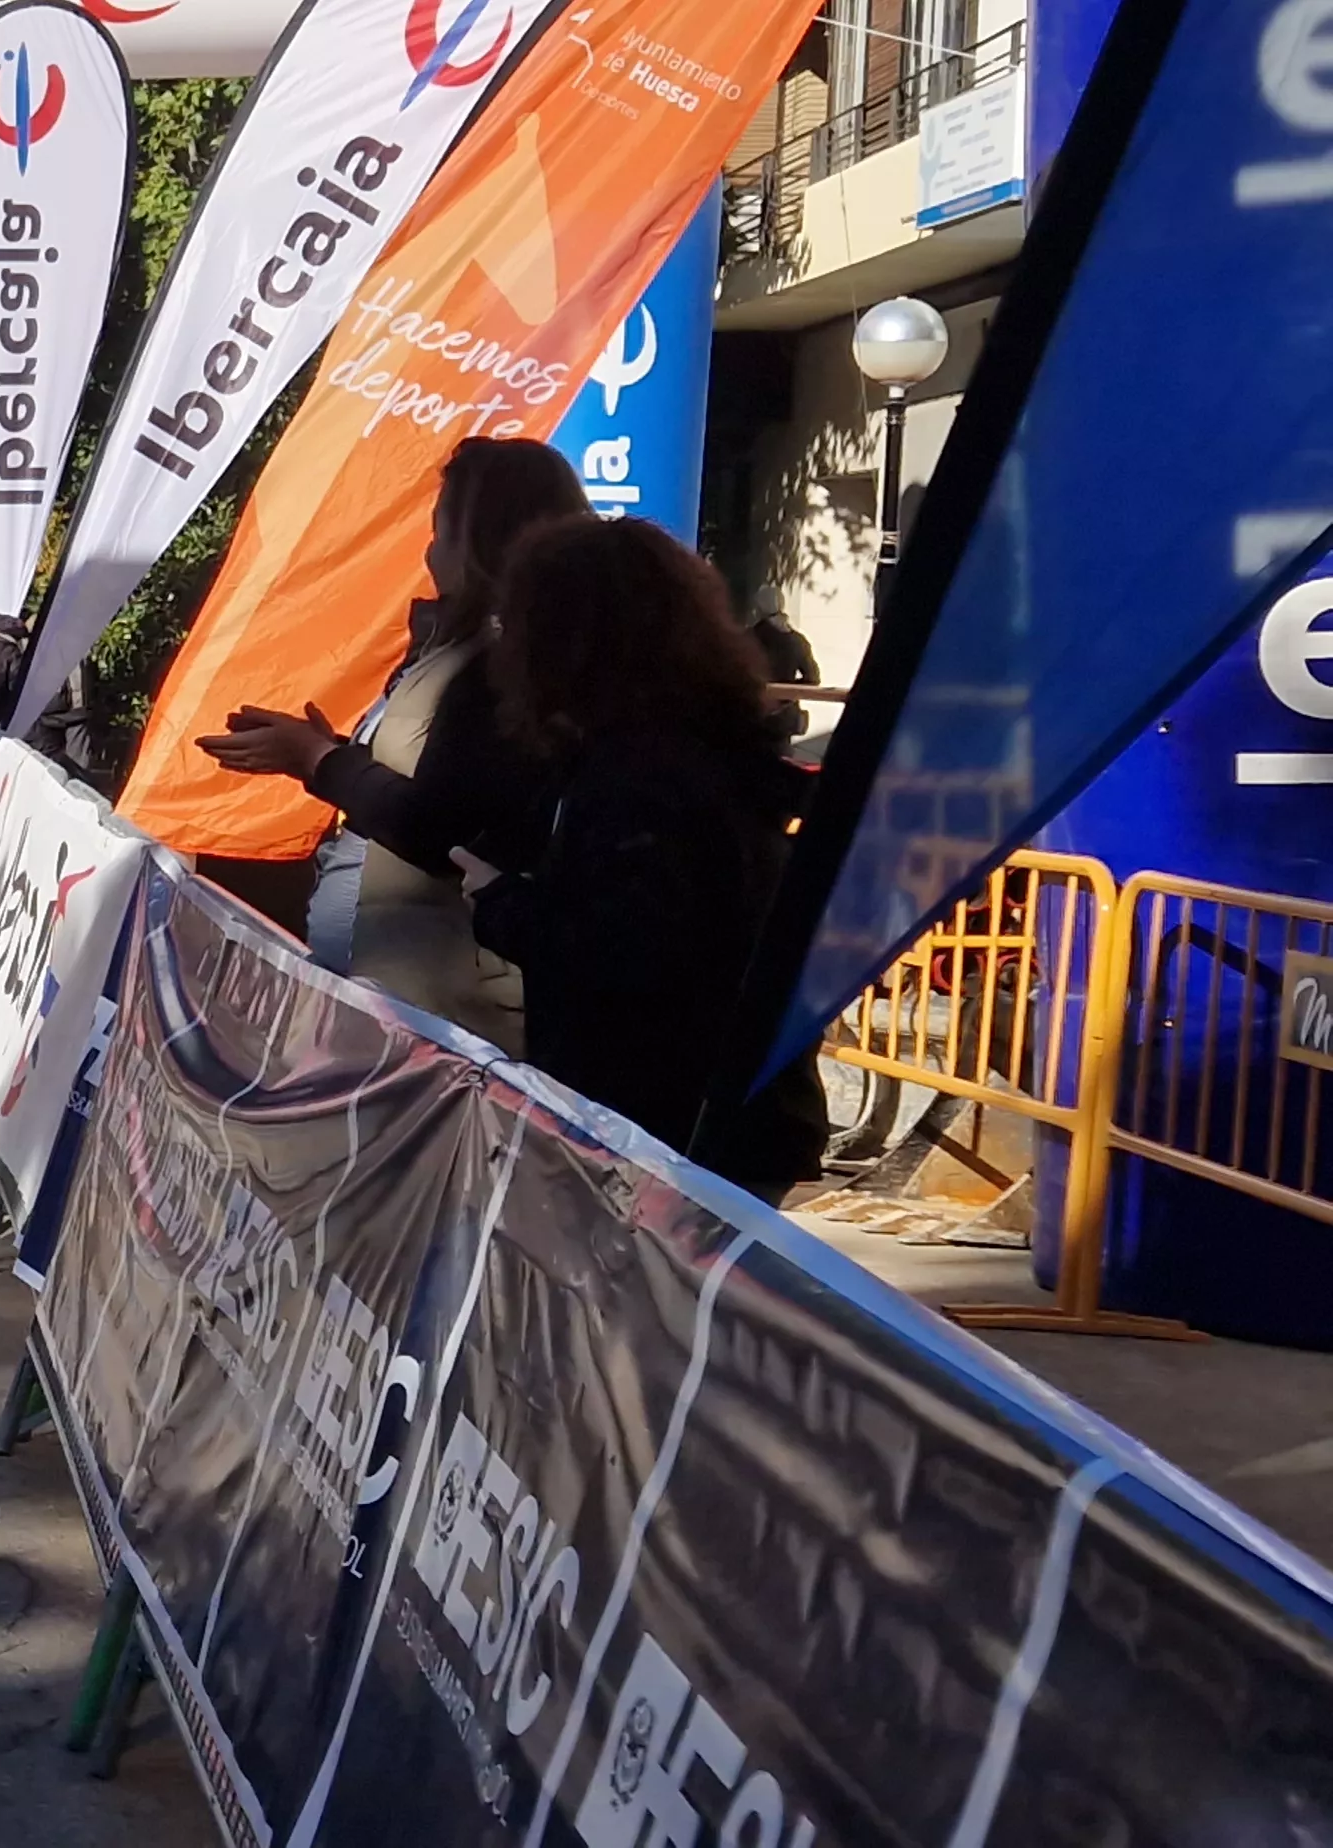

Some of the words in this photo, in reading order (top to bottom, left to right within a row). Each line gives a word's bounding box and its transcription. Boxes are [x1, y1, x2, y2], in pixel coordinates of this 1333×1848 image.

[628, 60, 700, 113] Huesca
[133, 135, 404, 481] Ibercaja
[350, 276, 570, 406] Hacemos
[441, 1449, 581, 1737] ESIC
